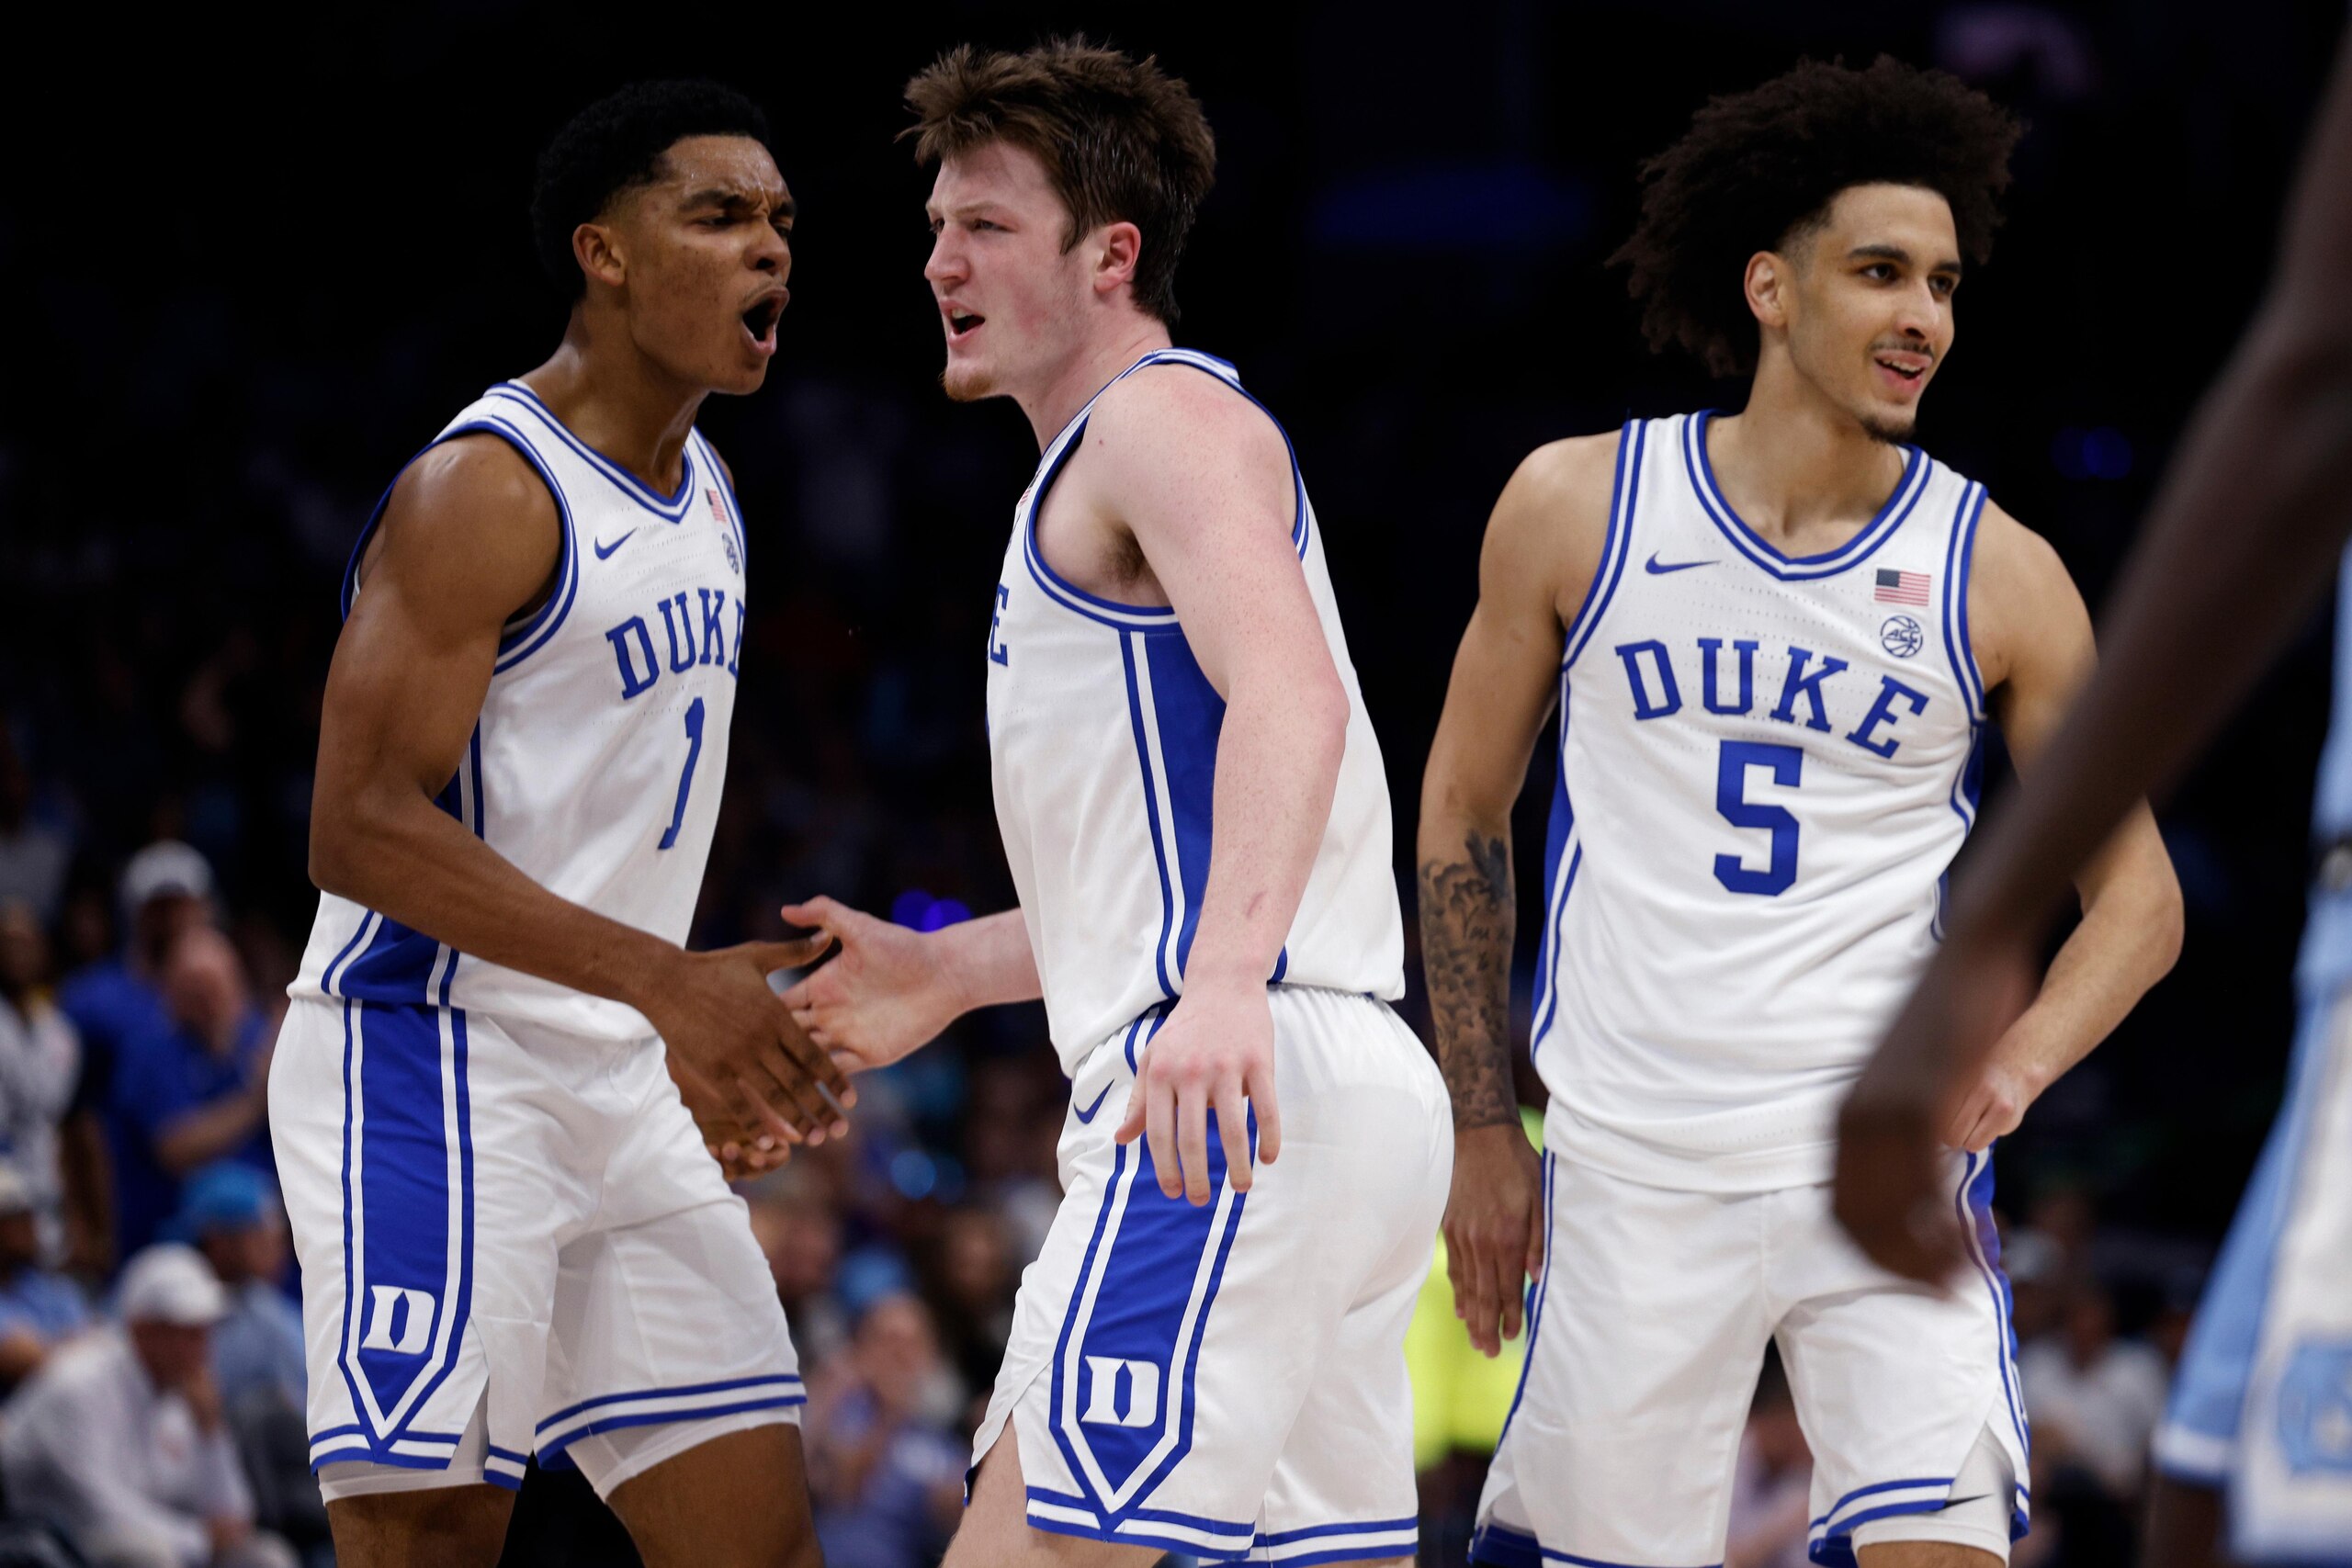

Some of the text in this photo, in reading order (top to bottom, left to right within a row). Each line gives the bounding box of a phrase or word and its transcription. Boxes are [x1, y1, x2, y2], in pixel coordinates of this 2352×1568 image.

[1615, 638, 1929, 760] DUKE
[657, 696, 705, 850] 1
[1713, 739, 1804, 897] 5
[361, 1284, 435, 1355] D
[1080, 1355, 1160, 1428] D
